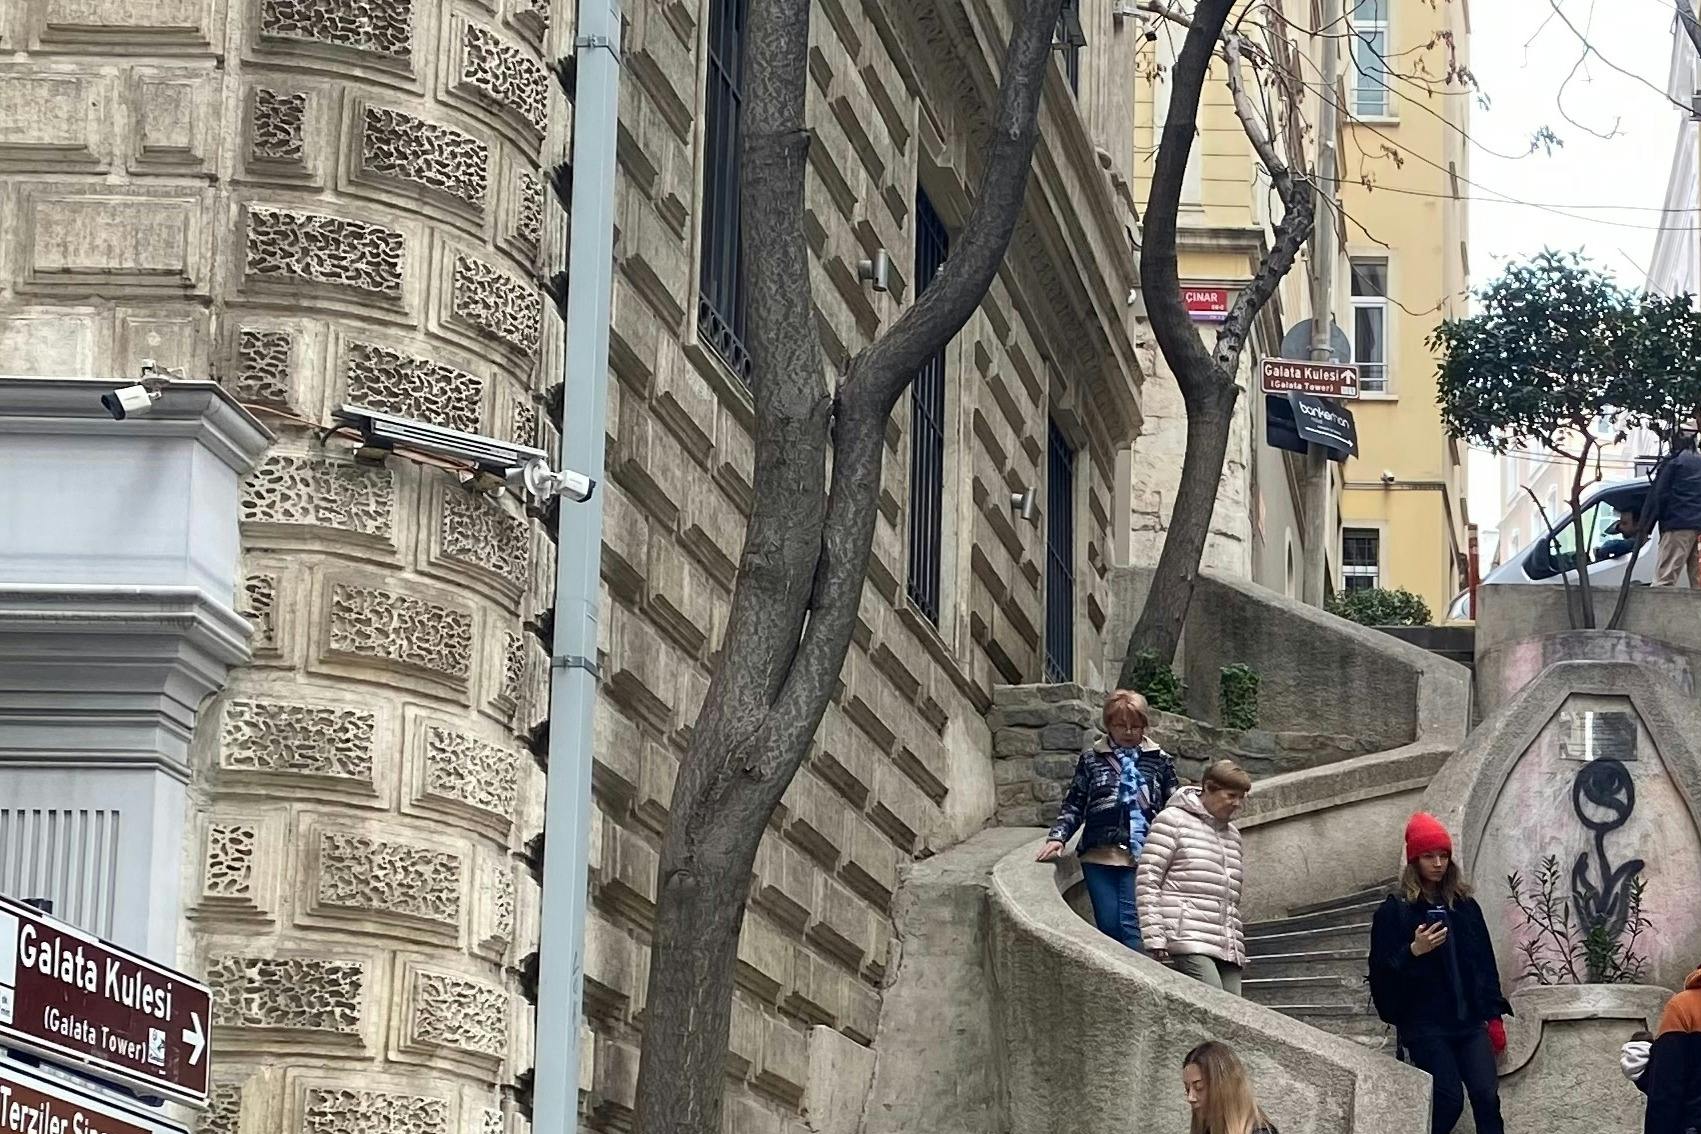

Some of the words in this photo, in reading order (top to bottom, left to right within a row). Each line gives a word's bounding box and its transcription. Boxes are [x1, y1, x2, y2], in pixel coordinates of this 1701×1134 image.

[1265, 364, 1302, 379] Galata
[1304, 367, 1339, 381] Kulesi
[20, 923, 97, 993] Galata
[105, 957, 172, 1021] Kulesi
[44, 1005, 97, 1045] (Galata
[101, 1026, 146, 1063] Tower)
